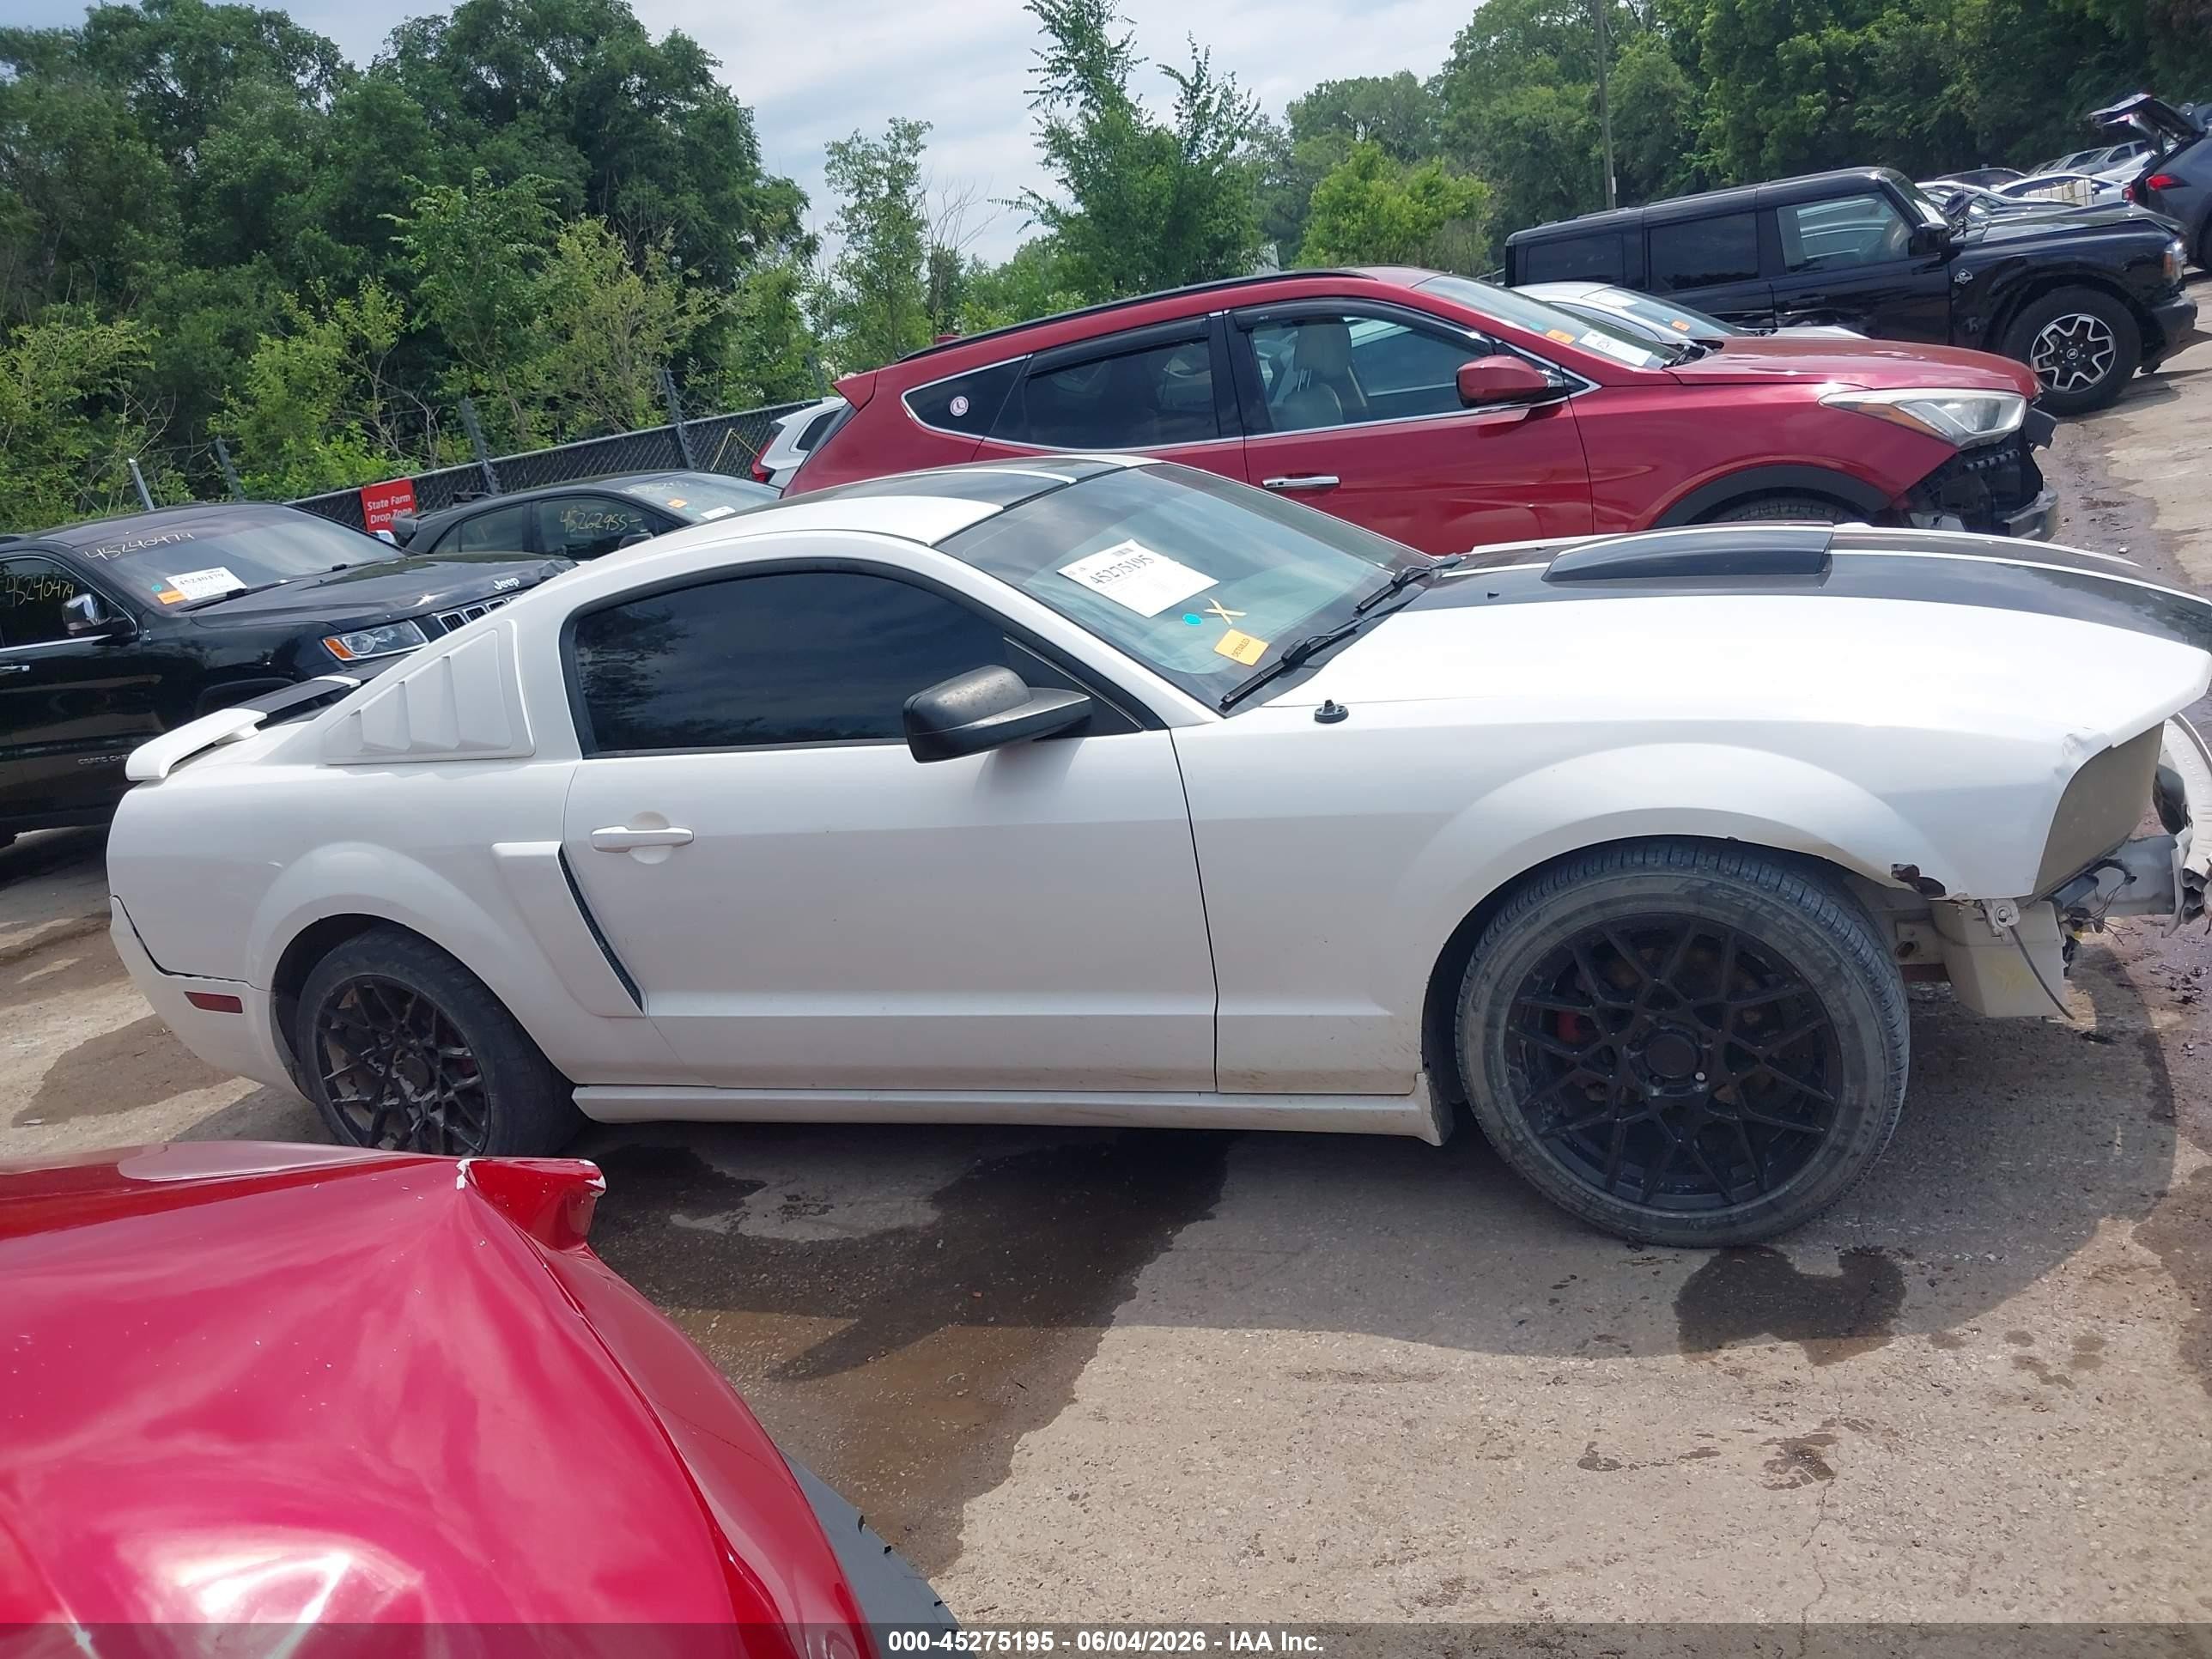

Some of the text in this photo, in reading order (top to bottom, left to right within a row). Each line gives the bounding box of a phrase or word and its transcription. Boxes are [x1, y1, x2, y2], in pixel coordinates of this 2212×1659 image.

[367, 494, 411, 512] State Farm
[370, 512, 392, 525] Drop
[1089, 554, 1155, 585] 45275195
[5, 574, 75, 607] 45240479
[493, 577, 520, 590] Jeep
